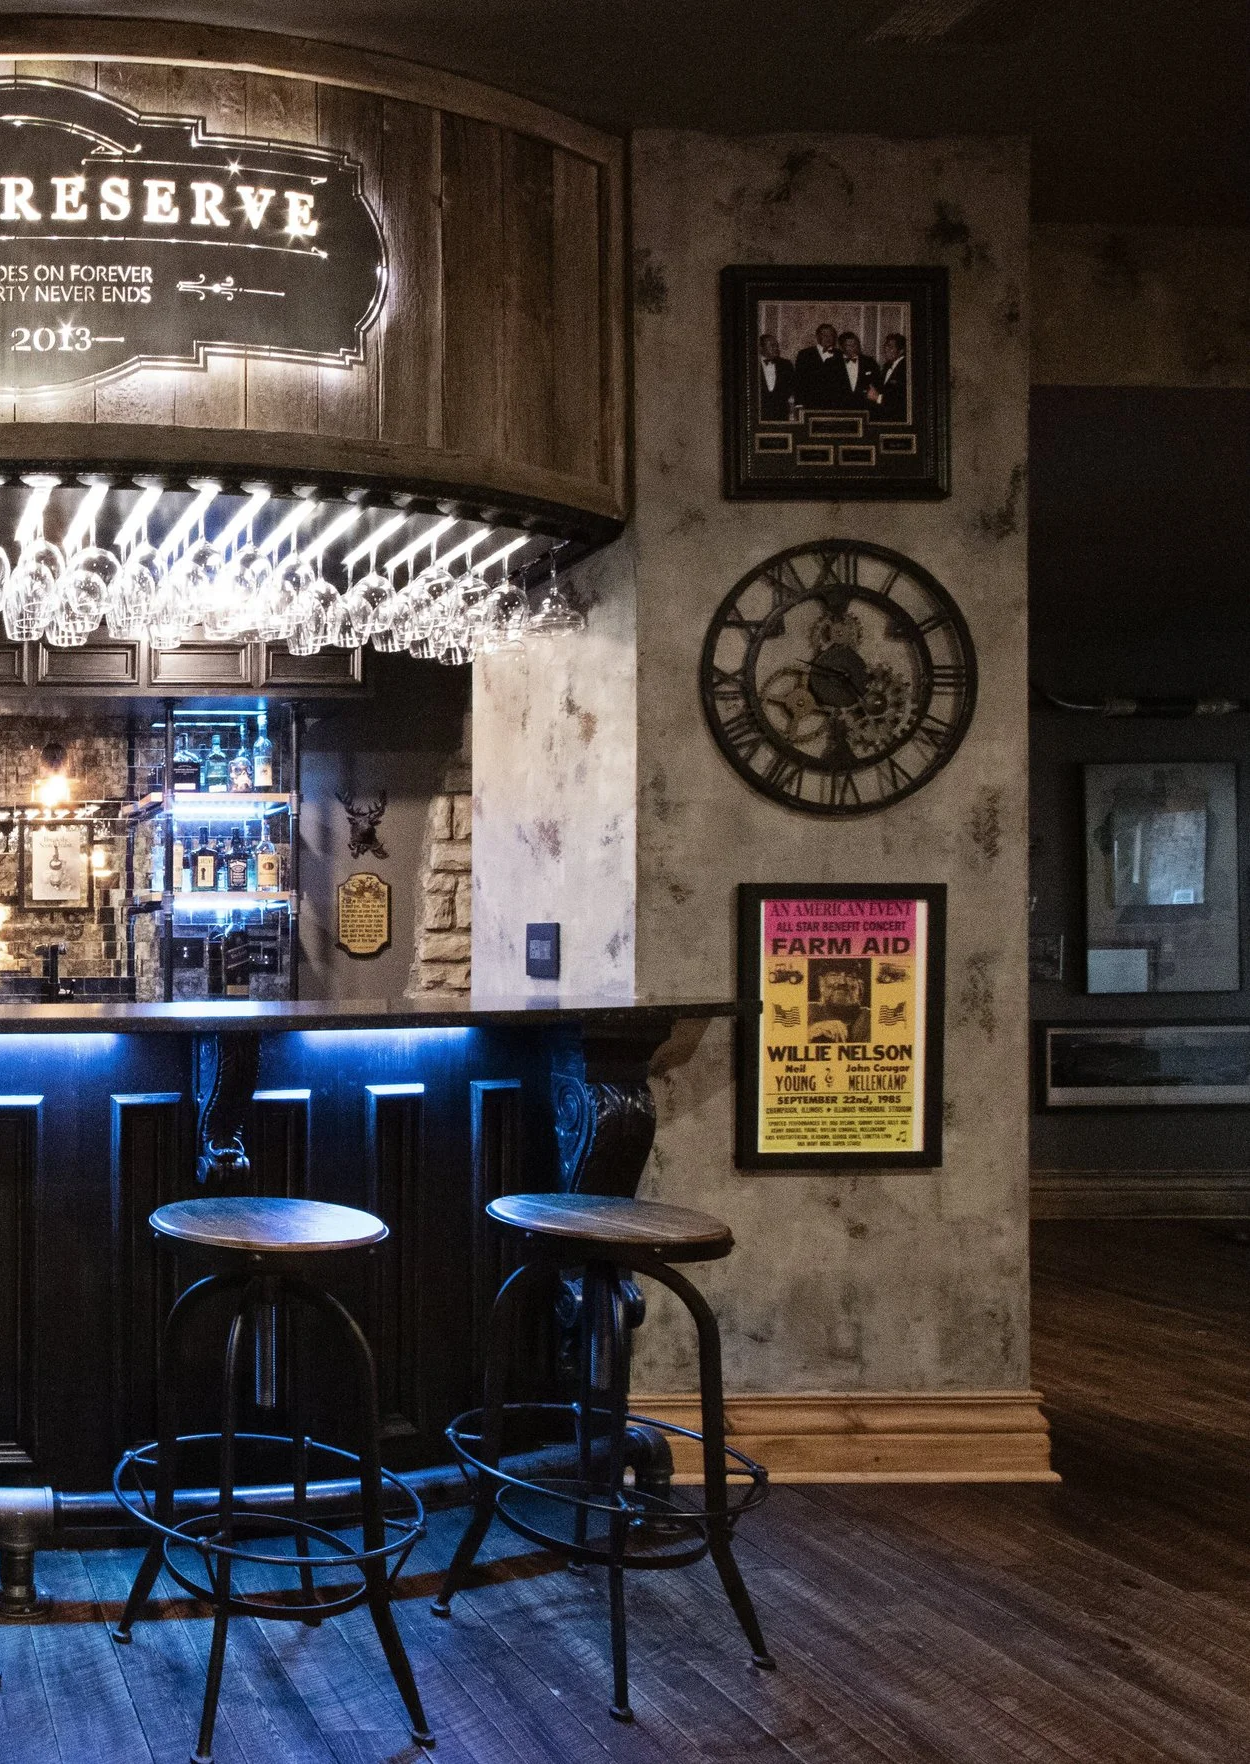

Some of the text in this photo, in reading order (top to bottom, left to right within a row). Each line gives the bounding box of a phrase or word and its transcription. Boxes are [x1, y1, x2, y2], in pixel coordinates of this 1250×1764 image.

[0, 177, 318, 236] RESERVE
[34, 265, 64, 283] ON
[70, 265, 154, 283] FOREVER
[35, 286, 95, 302] NEVER
[102, 286, 151, 303] ENDS
[11, 328, 92, 352] 2013
[770, 902, 912, 916] AN AMERICAN EVENT
[776, 921, 906, 932] ALL STAR BENEFIT CONCERT
[772, 937, 910, 955] FARM AID
[767, 1045, 912, 1062] WILLIE NELSON
[785, 1064, 806, 1073] Neil
[846, 1064, 910, 1074] John Cougar
[775, 1076, 816, 1091] YOUNG
[848, 1075, 907, 1091] MELLENCAMP
[777, 1095, 901, 1105] SEPTEMBER 22nd, 1985
